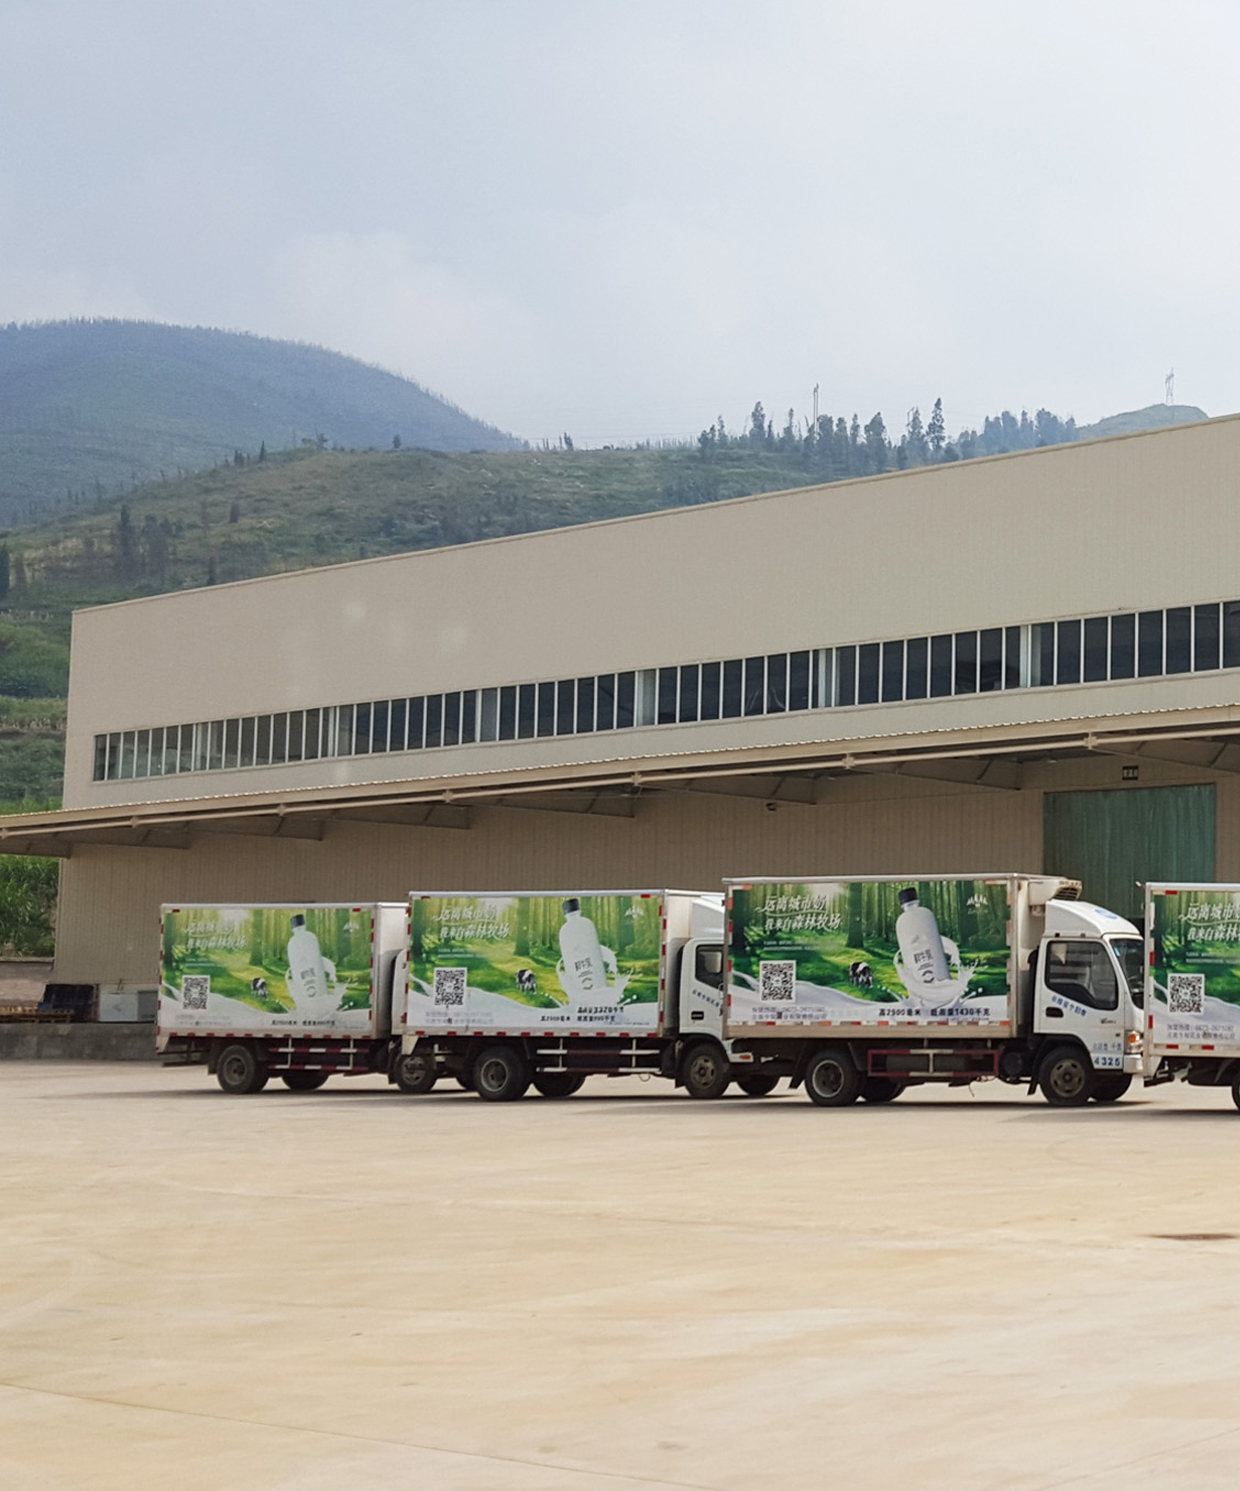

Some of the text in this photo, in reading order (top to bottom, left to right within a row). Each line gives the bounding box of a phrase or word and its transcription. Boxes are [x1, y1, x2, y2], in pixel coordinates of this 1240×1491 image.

[765, 913, 841, 932] 我来自森林牧场
